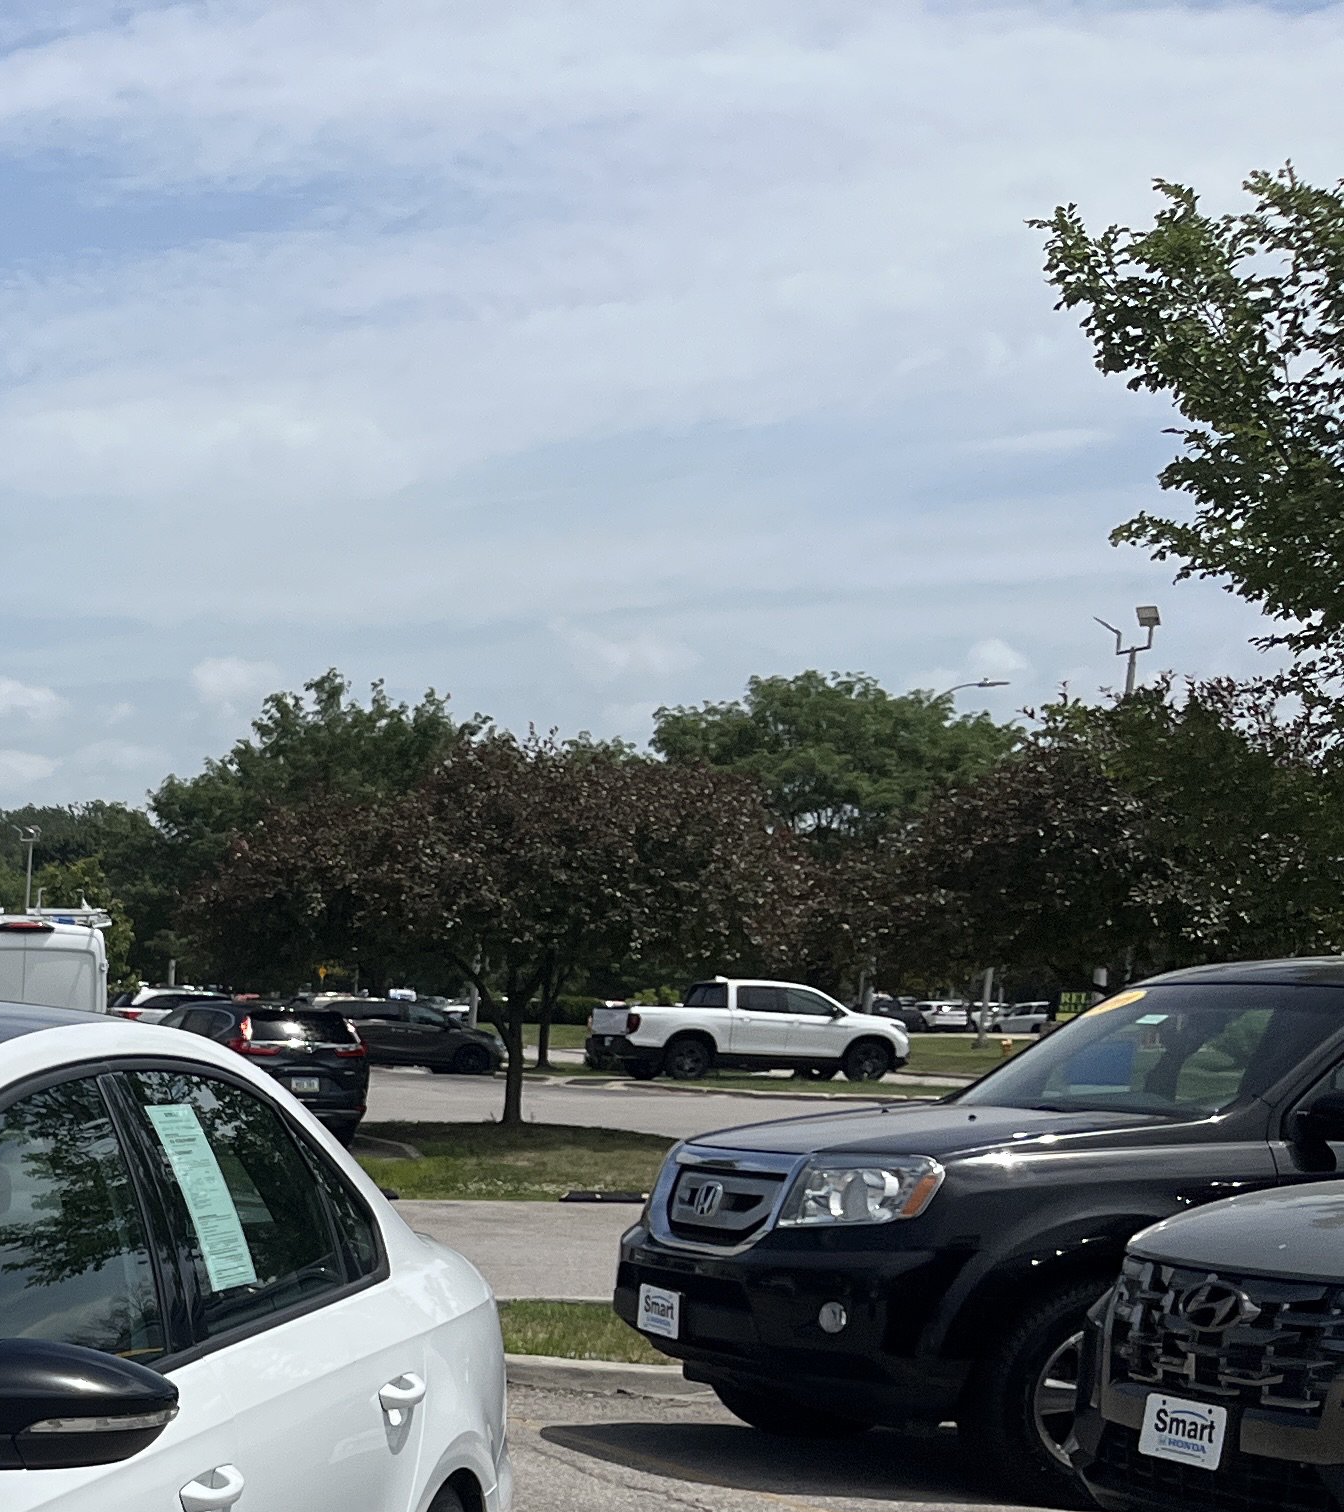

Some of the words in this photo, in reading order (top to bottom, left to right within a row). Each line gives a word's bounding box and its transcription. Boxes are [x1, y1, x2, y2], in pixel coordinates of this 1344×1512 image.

[644, 1294, 674, 1320] Smart
[1154, 1408, 1216, 1444] Smart
[1168, 1437, 1206, 1454] HONDA
